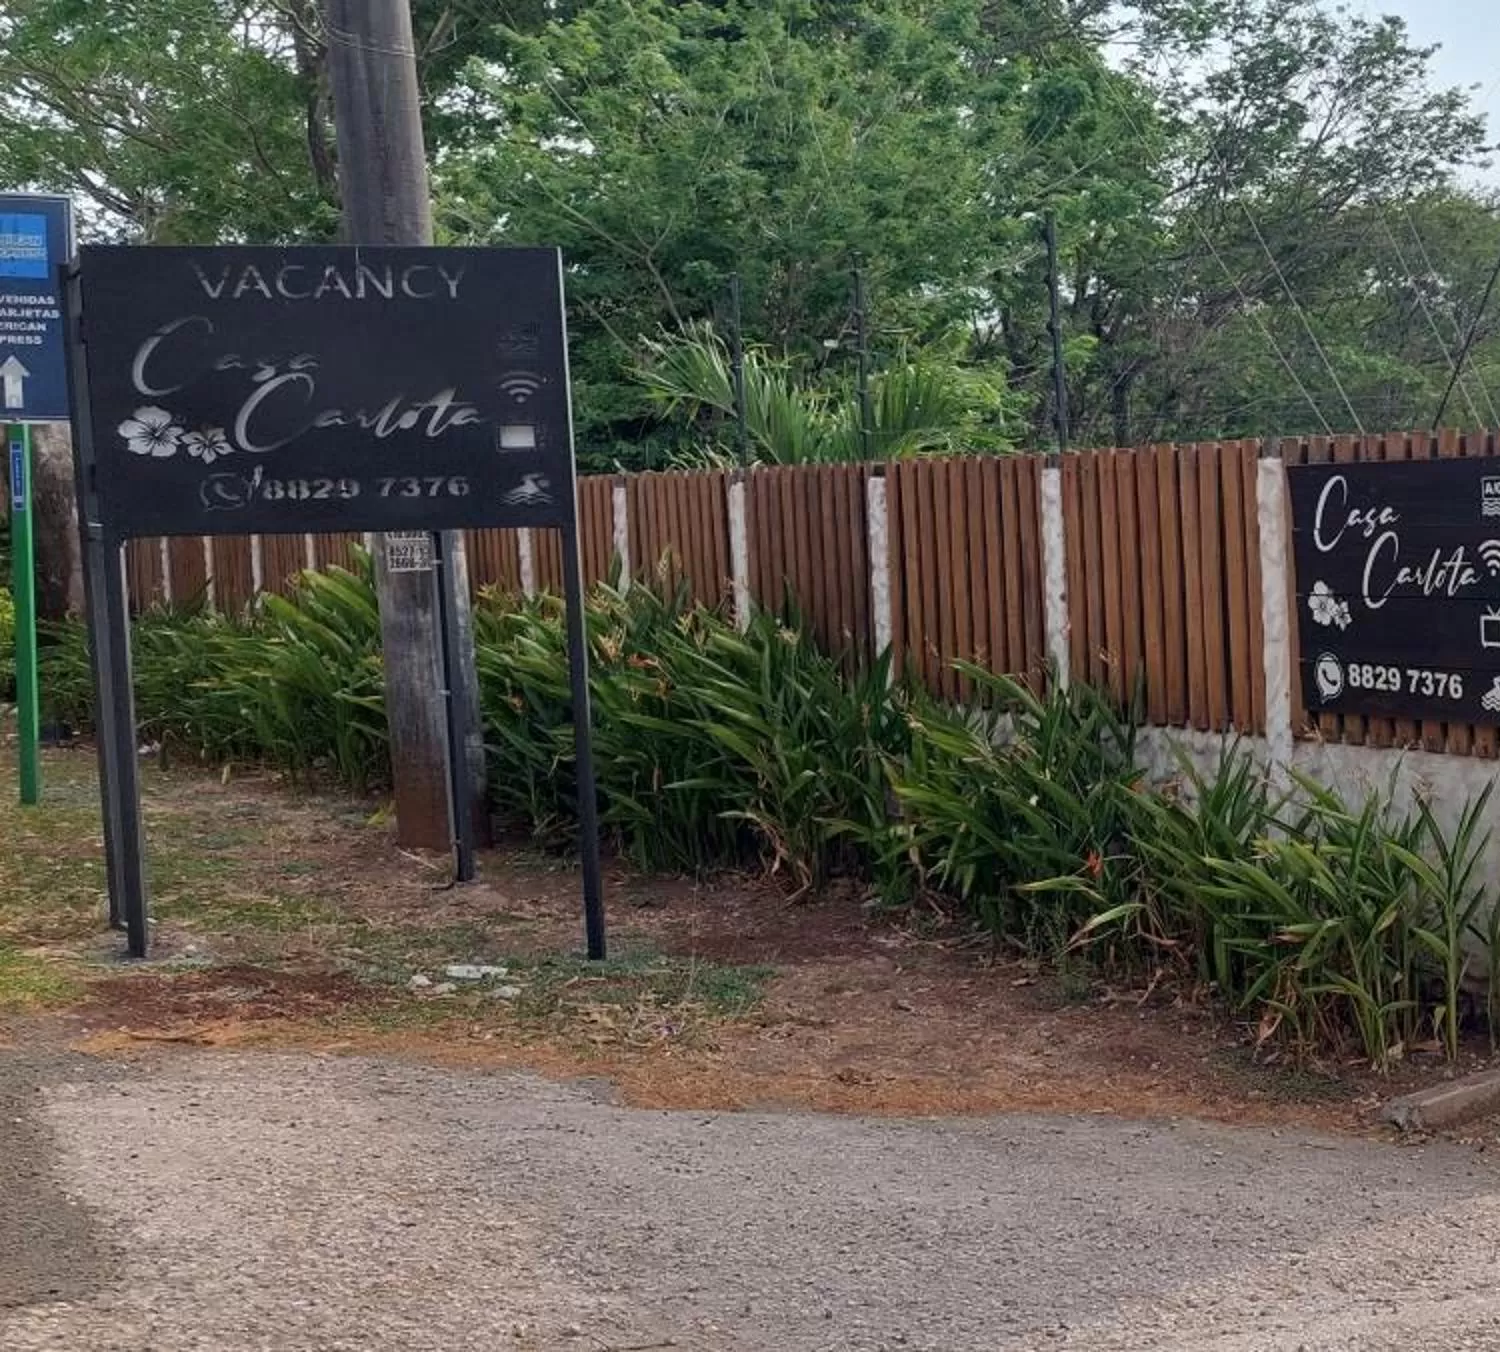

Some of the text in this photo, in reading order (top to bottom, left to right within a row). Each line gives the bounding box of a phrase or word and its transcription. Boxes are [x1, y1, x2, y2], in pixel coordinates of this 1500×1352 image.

[191, 264, 465, 299] VACANCY
[132, 315, 320, 396] Casa
[235, 372, 482, 452] Carlota
[263, 475, 471, 500] 8829 7376
[1313, 475, 1399, 552] Casa
[1362, 530, 1481, 609] Carlota
[1348, 663, 1464, 699] 8829 7376
